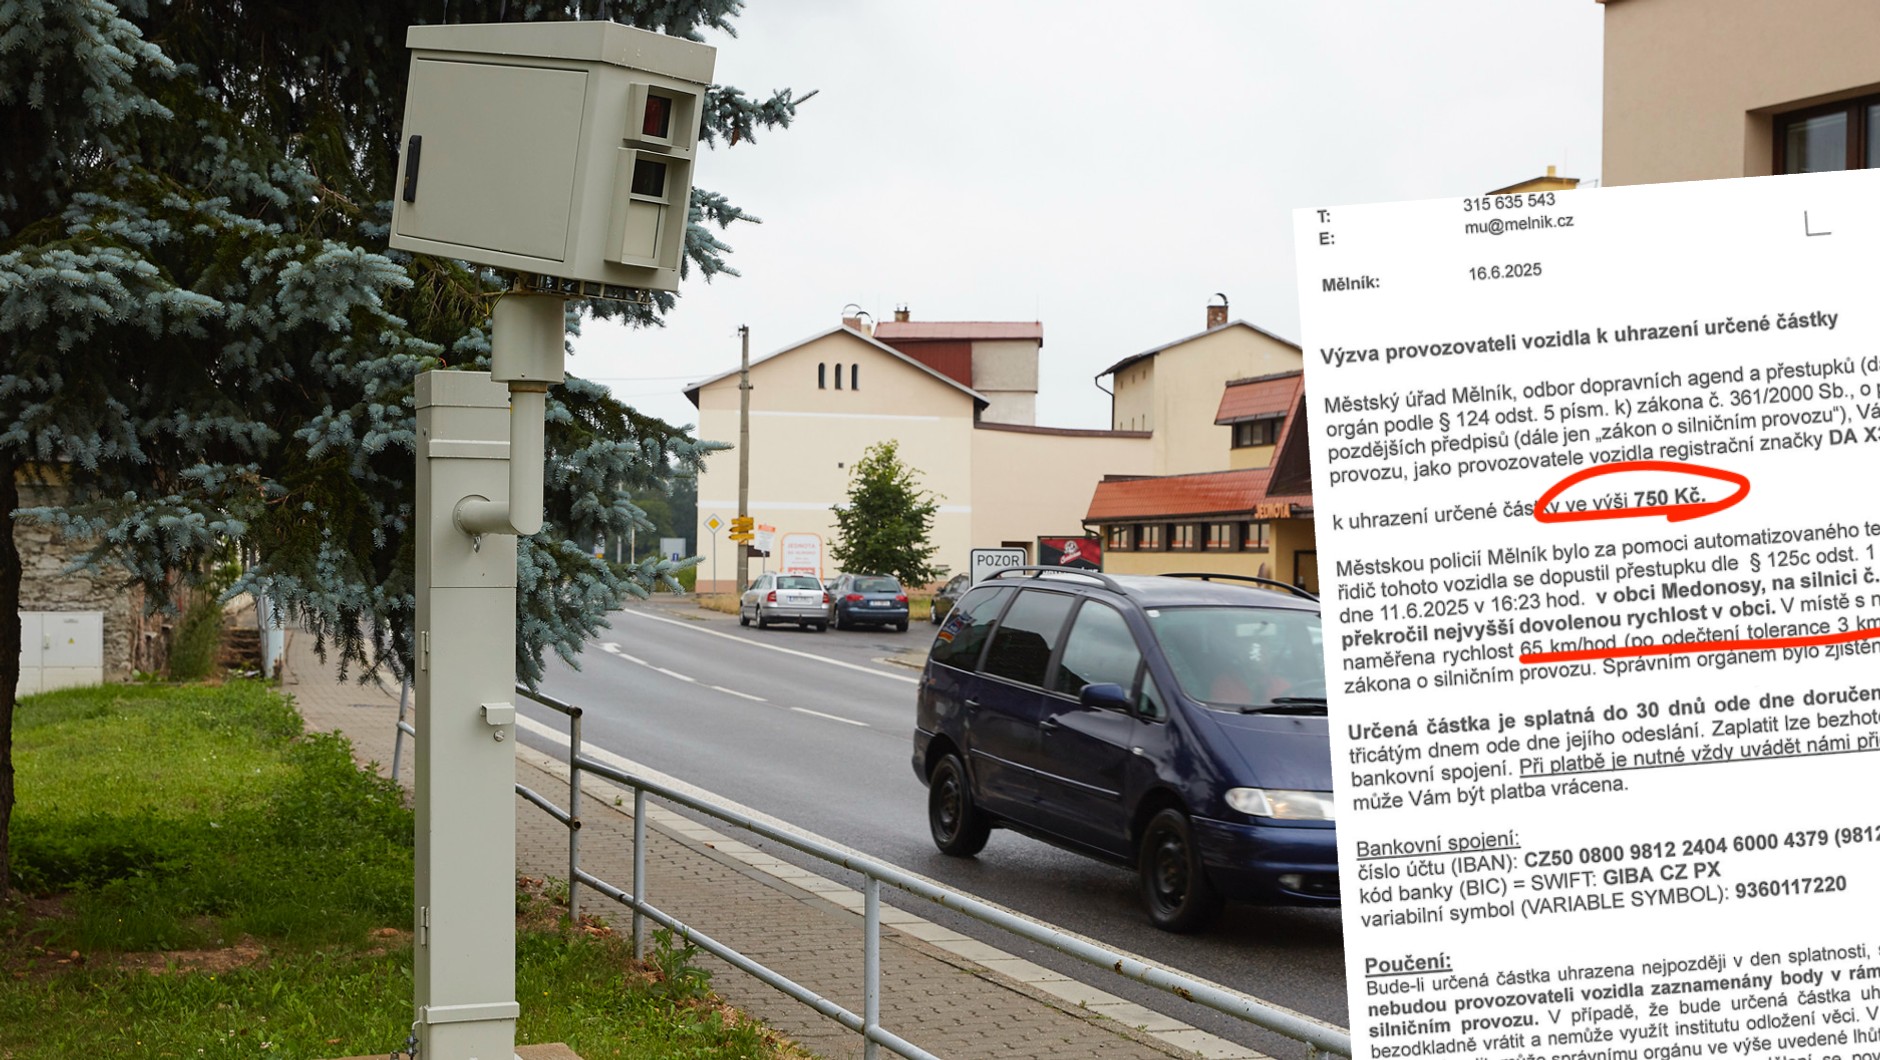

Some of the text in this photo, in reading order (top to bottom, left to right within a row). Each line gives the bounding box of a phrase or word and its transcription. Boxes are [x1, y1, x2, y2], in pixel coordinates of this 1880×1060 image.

[1317, 209, 1331, 223] T:
[1463, 192, 1556, 212] 315 635 543
[1465, 215, 1574, 235] mu@melnik.cz
[1319, 232, 1335, 245] E:
[1322, 263, 1542, 292] Mělník: 16.6.2025
[1320, 311, 1838, 368] Výzva provozovateli vozidla uhrazení určené částky
[1325, 357, 1854, 413] Městský úřad Mělník, odbor dopravních agend přestupků
[1326, 382, 1854, 440] orgán podle 124 písm. zákona 361/2000 Sb.,
[1329, 438, 1426, 464] pozdějších
[1431, 431, 1508, 456] předpisů
[1514, 428, 1558, 450] (dále
[1678, 413, 1756, 434] silničním
[1330, 428, 1858, 487] provozu, jako provozovatele vozidla registrační značky DA
[1349, 487, 1707, 529] uhrazení určené výši 750 Kč.
[977, 554, 1020, 567] POZOR
[1336, 523, 1859, 577] Městskou policií Mělník bylo pomoci automatizovaného
[1338, 546, 1858, 600] řidič tohoto vozidla dopustil přestupku 125c odst.
[1340, 569, 1857, 624] dne 11.6.2025 16:23 hod. obci Medonosy, silnici
[1342, 593, 1849, 651] překročil nejvyšší dovolenou rychlost obci. místě
[1343, 622, 1830, 670] naměřena rychlost 65 km/hod tolerance
[1345, 649, 1776, 694] zákona silničním provozu. Správním orgánem
[1348, 697, 1705, 740] Určená částka splatná 30 dnů
[1349, 716, 1779, 765] třicátým dnem jejího odeslání. Zaplatit
[1351, 734, 1850, 787] bankovní spojení. Při platbě nutné vždy uvádět námi
[1353, 778, 1628, 810] může Vám být platba vrácena.
[1357, 830, 1519, 857] Bankovní spojení:
[1358, 830, 1828, 881] číslo účtu (IBAN): CZ50 0800 9812 2404 6000 4379
[1360, 861, 1721, 904] kód banky (BIC) SWIFT: GIBA CZ PX
[1361, 875, 1846, 927] variabilní symbol (VARIABLE SYMBOL): 9360117220
[1365, 952, 1450, 973] Poučení:
[1367, 943, 1870, 996] Bude-li určená částka uhrazena nejpozději splatnosti,
[1368, 968, 1823, 1017] nebudou provozovateli vozidla zaznamenány body
[1369, 988, 1851, 1038] silničním provozu. případě, určená částka
[1371, 1011, 1815, 1059] bezodkladně odložení
